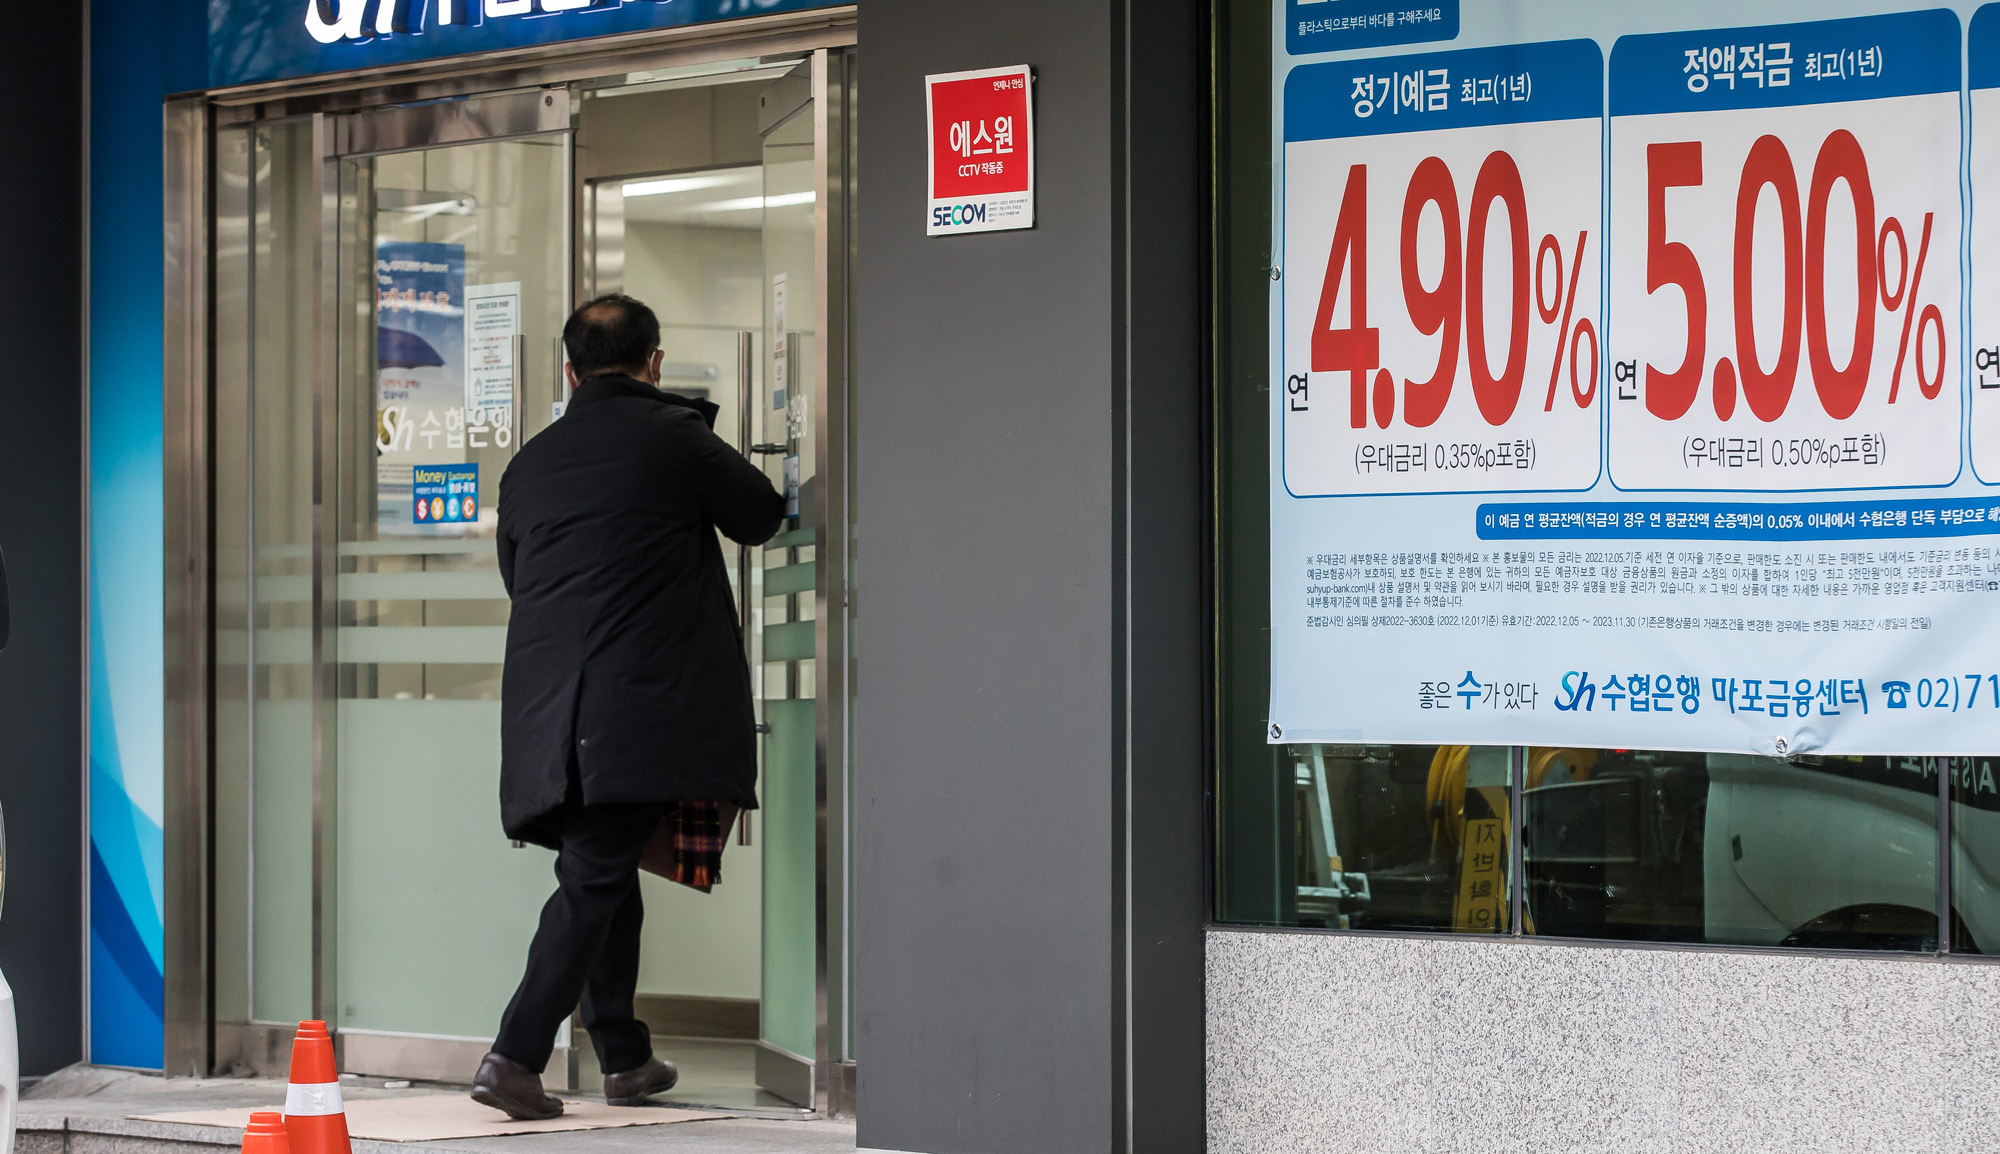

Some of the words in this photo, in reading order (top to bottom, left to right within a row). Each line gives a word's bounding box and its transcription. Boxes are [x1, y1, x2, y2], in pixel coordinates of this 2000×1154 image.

[1298, 15, 1367, 36] 플라스틱으로부터
[1369, 12, 1394, 28] 바다를
[1397, 8, 1441, 26] 구해주세요
[1683, 42, 1794, 93] 정액적금
[1804, 46, 1883, 81] 최고(1년)
[992, 80, 1010, 91] 언제나
[1012, 78, 1024, 89] 안심
[1351, 68, 1450, 118] 정기예금
[1460, 72, 1532, 106] 최고(1년)
[950, 116, 1014, 158] 에스원
[958, 164, 980, 177] CCTV
[981, 162, 1004, 175] 작동중
[933, 203, 986, 227] SECOM
[1615, 359, 1637, 400] 연
[1646, 128, 1946, 422] 5.00%
[1288, 372, 1308, 412] 연
[1311, 150, 1598, 430] 4.90%
[376, 406, 414, 452] Sh
[419, 406, 512, 448] 수협은행
[1355, 441, 1428, 475] (우대금리
[1434, 439, 1536, 473] 0.35%p포함)
[1682, 436, 1764, 468] (우대금리
[1772, 432, 1886, 468] 0.50%p포함)
[416, 470, 446, 486] Money
[448, 472, 476, 481] Exchange
[1485, 514, 1495, 528] 이
[1499, 514, 1520, 528] 예금
[1524, 513, 1534, 527] 연
[1539, 512, 1618, 528] 평균잔액(적금의
[1624, 513, 1645, 527] 경우
[1650, 513, 1660, 527] 연
[1665, 513, 1709, 528] 평균잔액
[1714, 513, 1763, 529] 순증액)의
[1768, 515, 1803, 529] 0.05%
[1808, 512, 1854, 528] 이내에서
[1859, 511, 1907, 527] 수협은행
[1912, 510, 1936, 525] 단독
[1940, 509, 1984, 524] 부담으로
[1988, 507, 2000, 522] 해
[1316, 554, 1346, 566] 우대금리
[1350, 553, 1388, 565] 세부항목은
[1391, 553, 1437, 565] 상품설명서를
[1441, 552, 1479, 564] 확인하세요
[1492, 552, 1500, 563] 본
[1539, 552, 1554, 563] 모든
[1558, 551, 1582, 563] 금리는
[1646, 552, 1662, 564] 세전
[1667, 552, 1674, 564] 연
[1708, 553, 1743, 566] 기준으로,
[1747, 554, 1781, 566] 판매한도
[1785, 554, 1801, 566] 소진
[1806, 554, 1813, 565] 시
[1818, 554, 1836, 565] 또는
[1841, 552, 1875, 565] 판매한도
[1879, 551, 1914, 564] 내에서도
[1973, 548, 1990, 560] 등의
[1307, 568, 1360, 580] 예금보험공사가
[1364, 567, 1396, 579] 보호하되,
[1400, 567, 1415, 577] 보호
[1420, 567, 1442, 579] 한도는
[1447, 567, 1454, 578] 본
[1458, 567, 1481, 578] 은행에
[1486, 567, 1501, 578] 있는
[1506, 566, 1529, 578] 귀하의
[1534, 566, 1550, 578] 모든
[1555, 566, 1596, 578] 예금자보호
[1602, 566, 1617, 578] 대상
[1623, 566, 1665, 579] 금융상품의
[1671, 567, 1697, 579] 원금과
[1702, 568, 1727, 580] 소정의
[1732, 568, 1759, 581] 이자를
[1764, 569, 1789, 581] 합하여
[1795, 569, 1817, 581] 1인당
[1307, 596, 1360, 608] 내부통제기준에
[1363, 596, 1378, 608] 따른
[1381, 596, 1403, 608] 절차를
[1406, 596, 1421, 607] 준수
[1424, 596, 1463, 607] 하였습니다.
[1379, 582, 1393, 593] 상품
[1397, 582, 1419, 593] 설명서
[1424, 581, 1430, 593] 및
[1434, 581, 1457, 593] 약관을
[1461, 581, 1476, 593] 읽어
[1480, 581, 1502, 593] 보시기
[1507, 581, 1532, 593] 바라며,
[1536, 581, 1559, 593] 필요한
[1563, 581, 1579, 593] 경우
[1583, 581, 1606, 593] 설명을
[1610, 581, 1626, 593] 받을
[1630, 581, 1656, 593] 권리가
[1660, 582, 1695, 594] 있습니다.
[1710, 583, 1718, 593] 그
[1722, 583, 1737, 595] 밖의
[1742, 584, 1767, 596] 상품에
[1772, 585, 1789, 597] 대한
[1793, 584, 1819, 596] 자세한
[1824, 583, 1848, 596] 내용은
[1853, 583, 1880, 595] 가까운
[1884, 582, 1908, 595] 영업점
[1307, 616, 1343, 627] 준법감시인
[1346, 616, 1368, 627] 심의필
[1638, 616, 1700, 629] (기존은행상품의
[1704, 618, 1744, 631] 거래조건을
[1747, 620, 1773, 632] 변경한
[1776, 620, 1810, 632] 경우에는
[1813, 620, 1839, 632] 변경된
[1843, 619, 1874, 631] 거래조건
[1910, 617, 1931, 629] 전일)
[1418, 682, 1452, 709] 좋은
[1504, 682, 1538, 710] 있다
[1554, 671, 1596, 712] Sh
[1602, 673, 1700, 714] 수협은행
[1712, 678, 1868, 718] 마포금융센터
